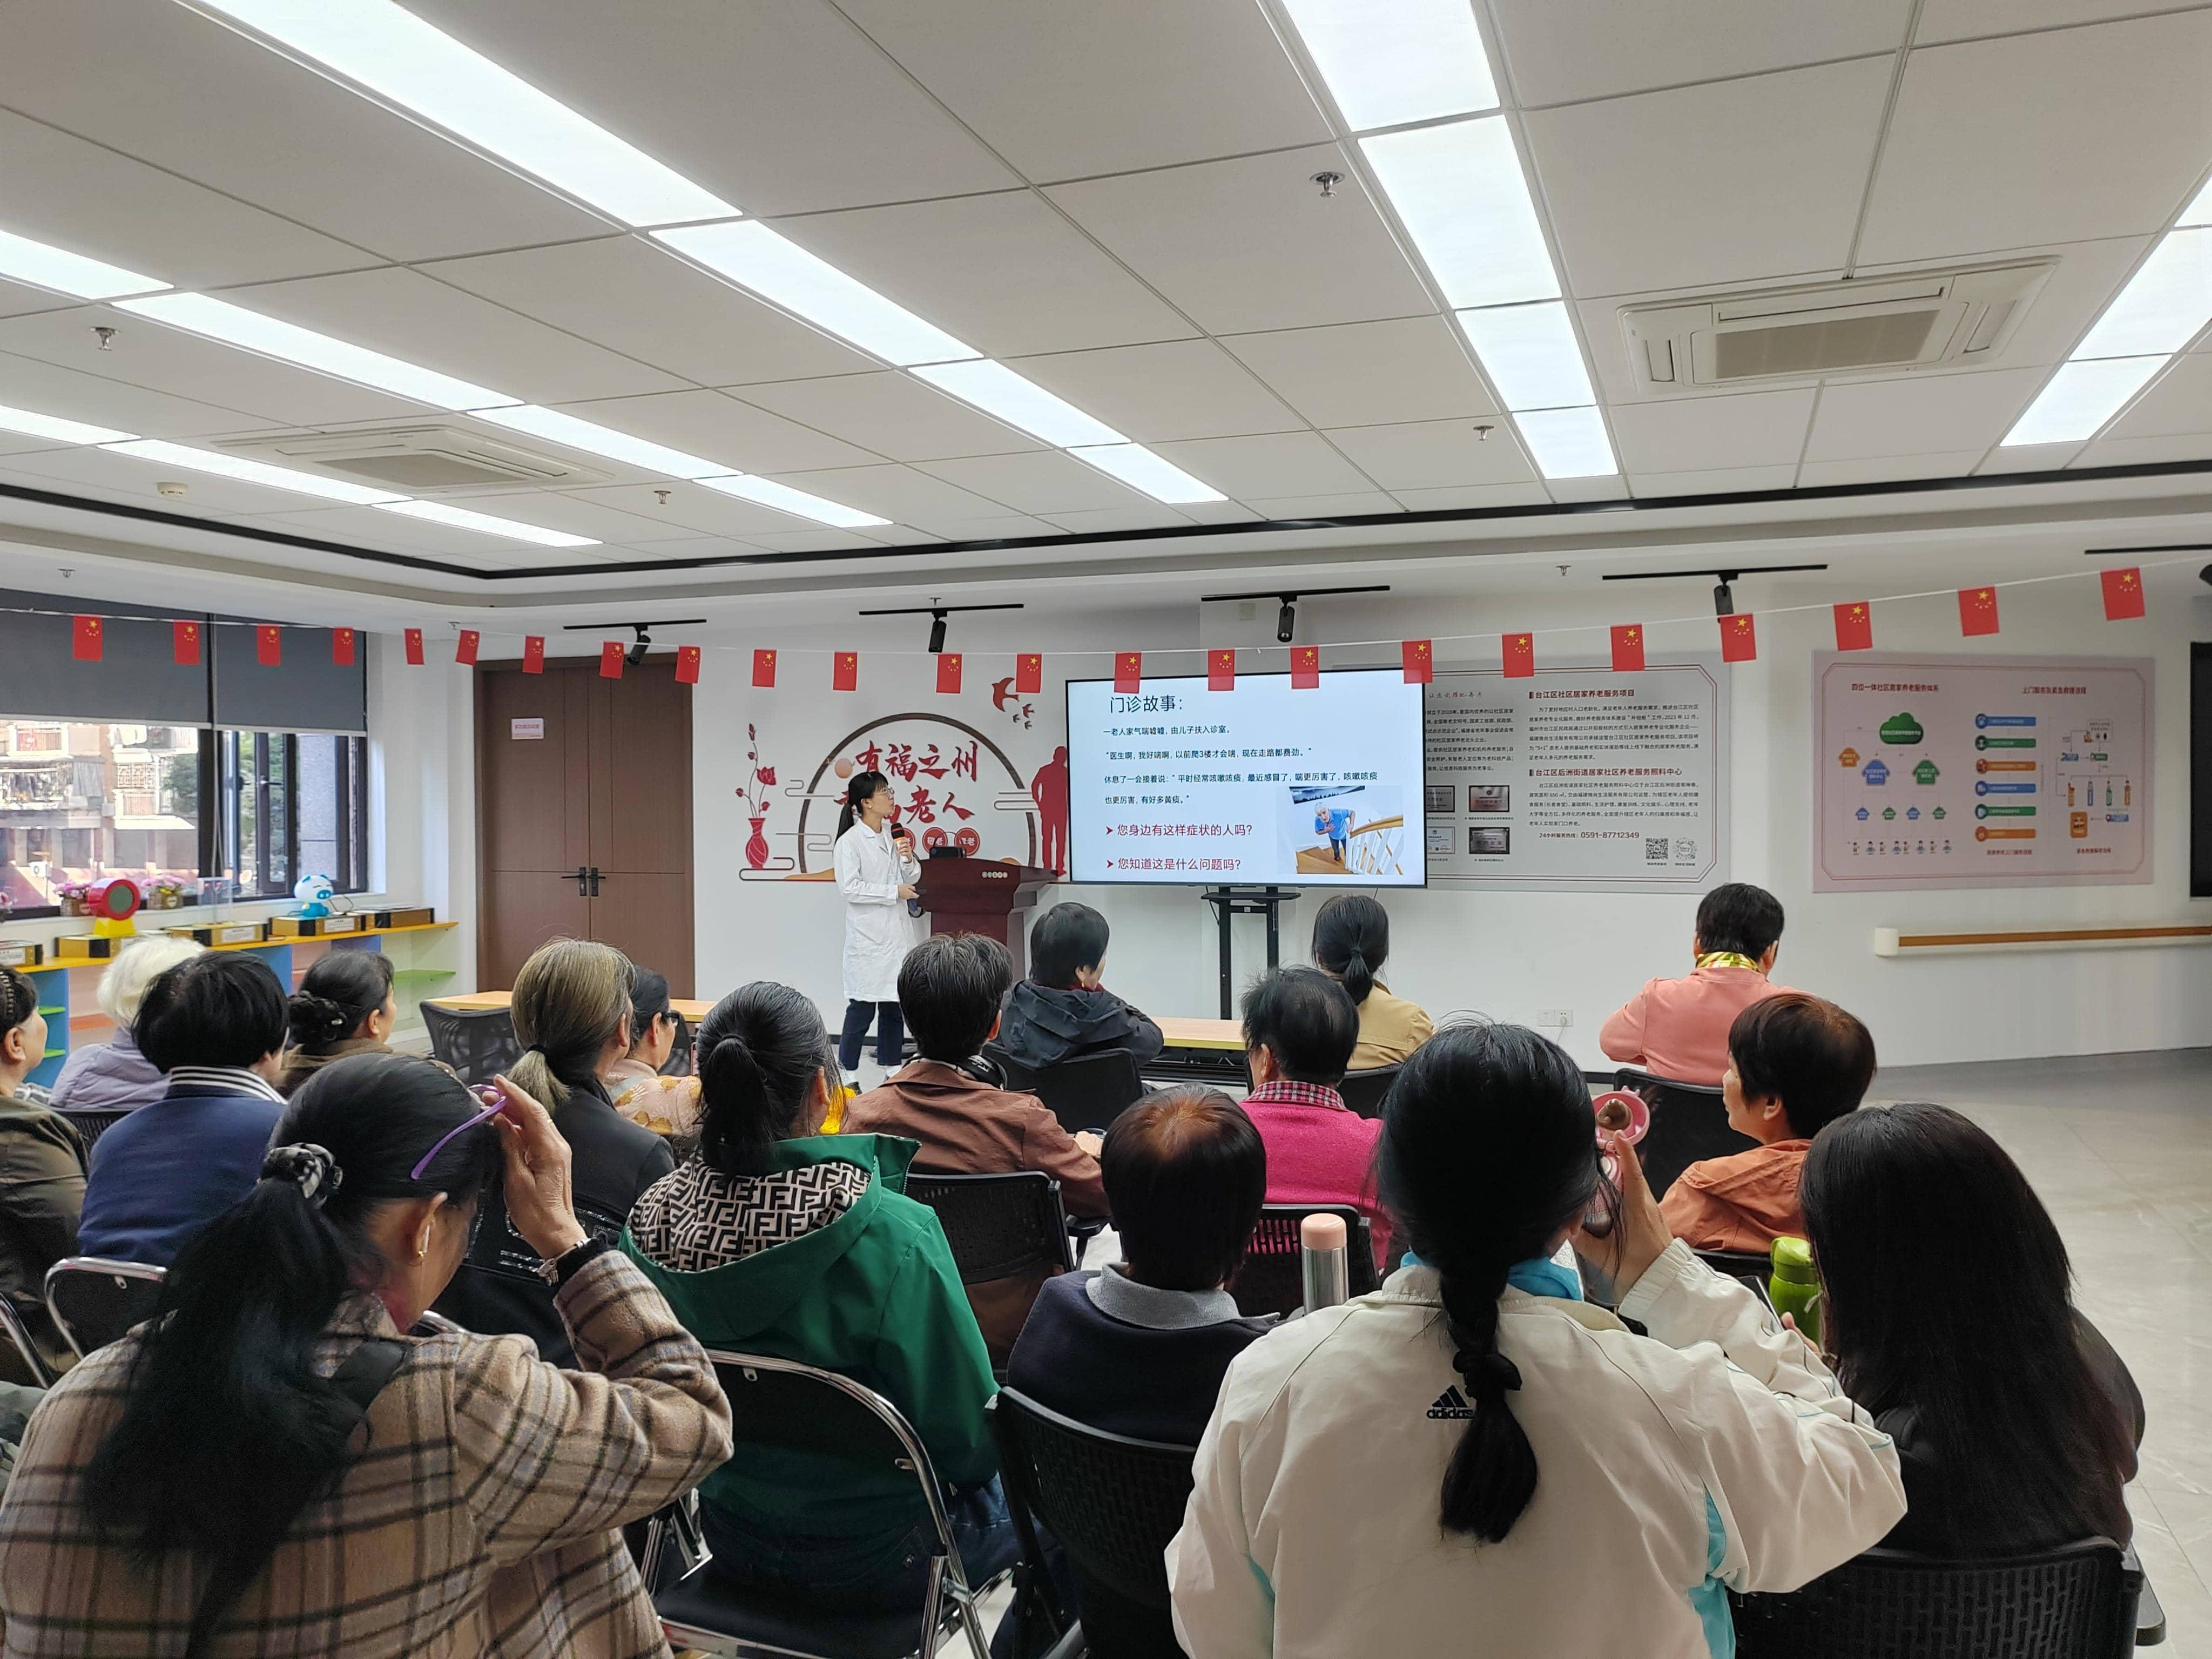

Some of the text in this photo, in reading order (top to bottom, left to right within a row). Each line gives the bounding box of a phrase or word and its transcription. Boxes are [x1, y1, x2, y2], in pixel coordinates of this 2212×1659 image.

[1536, 690, 1634, 698] 台江区社区居家养老服务项目
[855, 740, 977, 782] 有福之州
[1426, 1407, 1474, 1419] adidas
